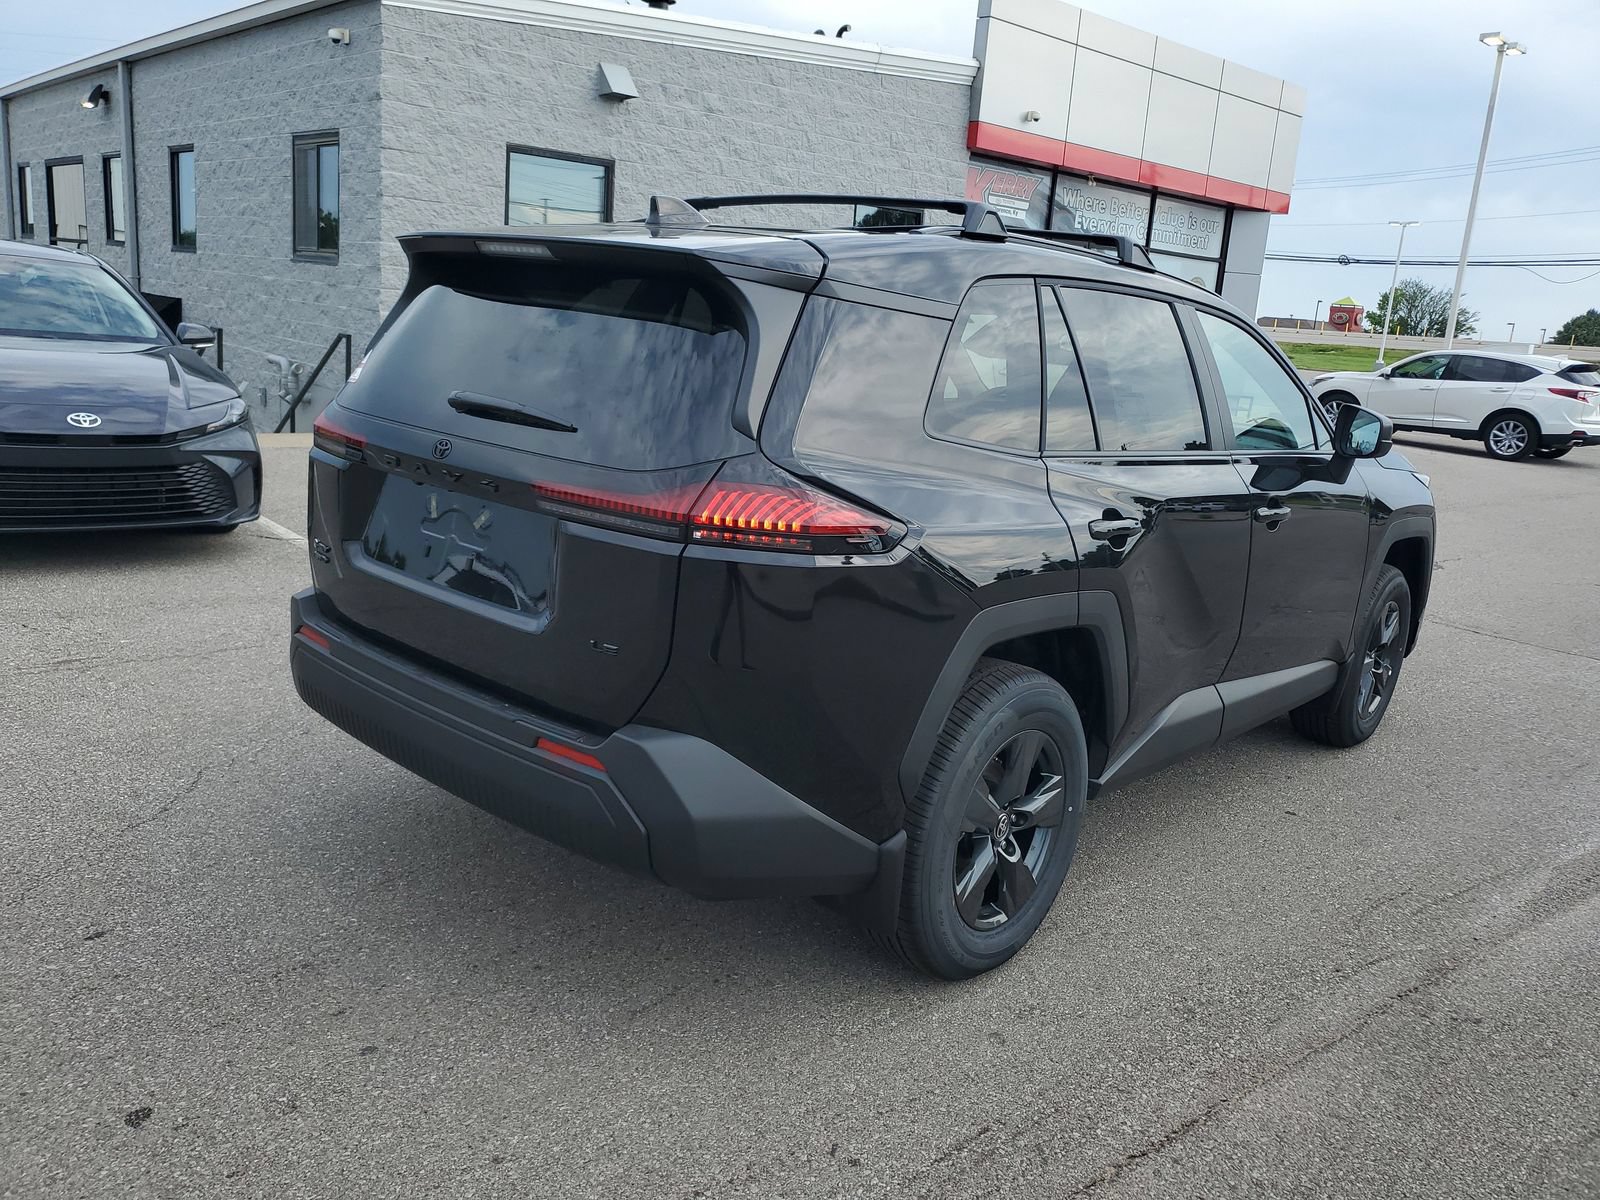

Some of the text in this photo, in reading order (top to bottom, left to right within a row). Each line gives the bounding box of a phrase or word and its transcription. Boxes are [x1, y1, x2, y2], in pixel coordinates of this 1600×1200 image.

[965, 165, 1041, 203] KERRY
[1062, 187, 1106, 213] Where
[1110, 197, 1149, 220] Better
[1188, 211, 1198, 230] is
[1200, 218, 1220, 234] our
[1074, 209, 1209, 250] Everyday Cmmitment
